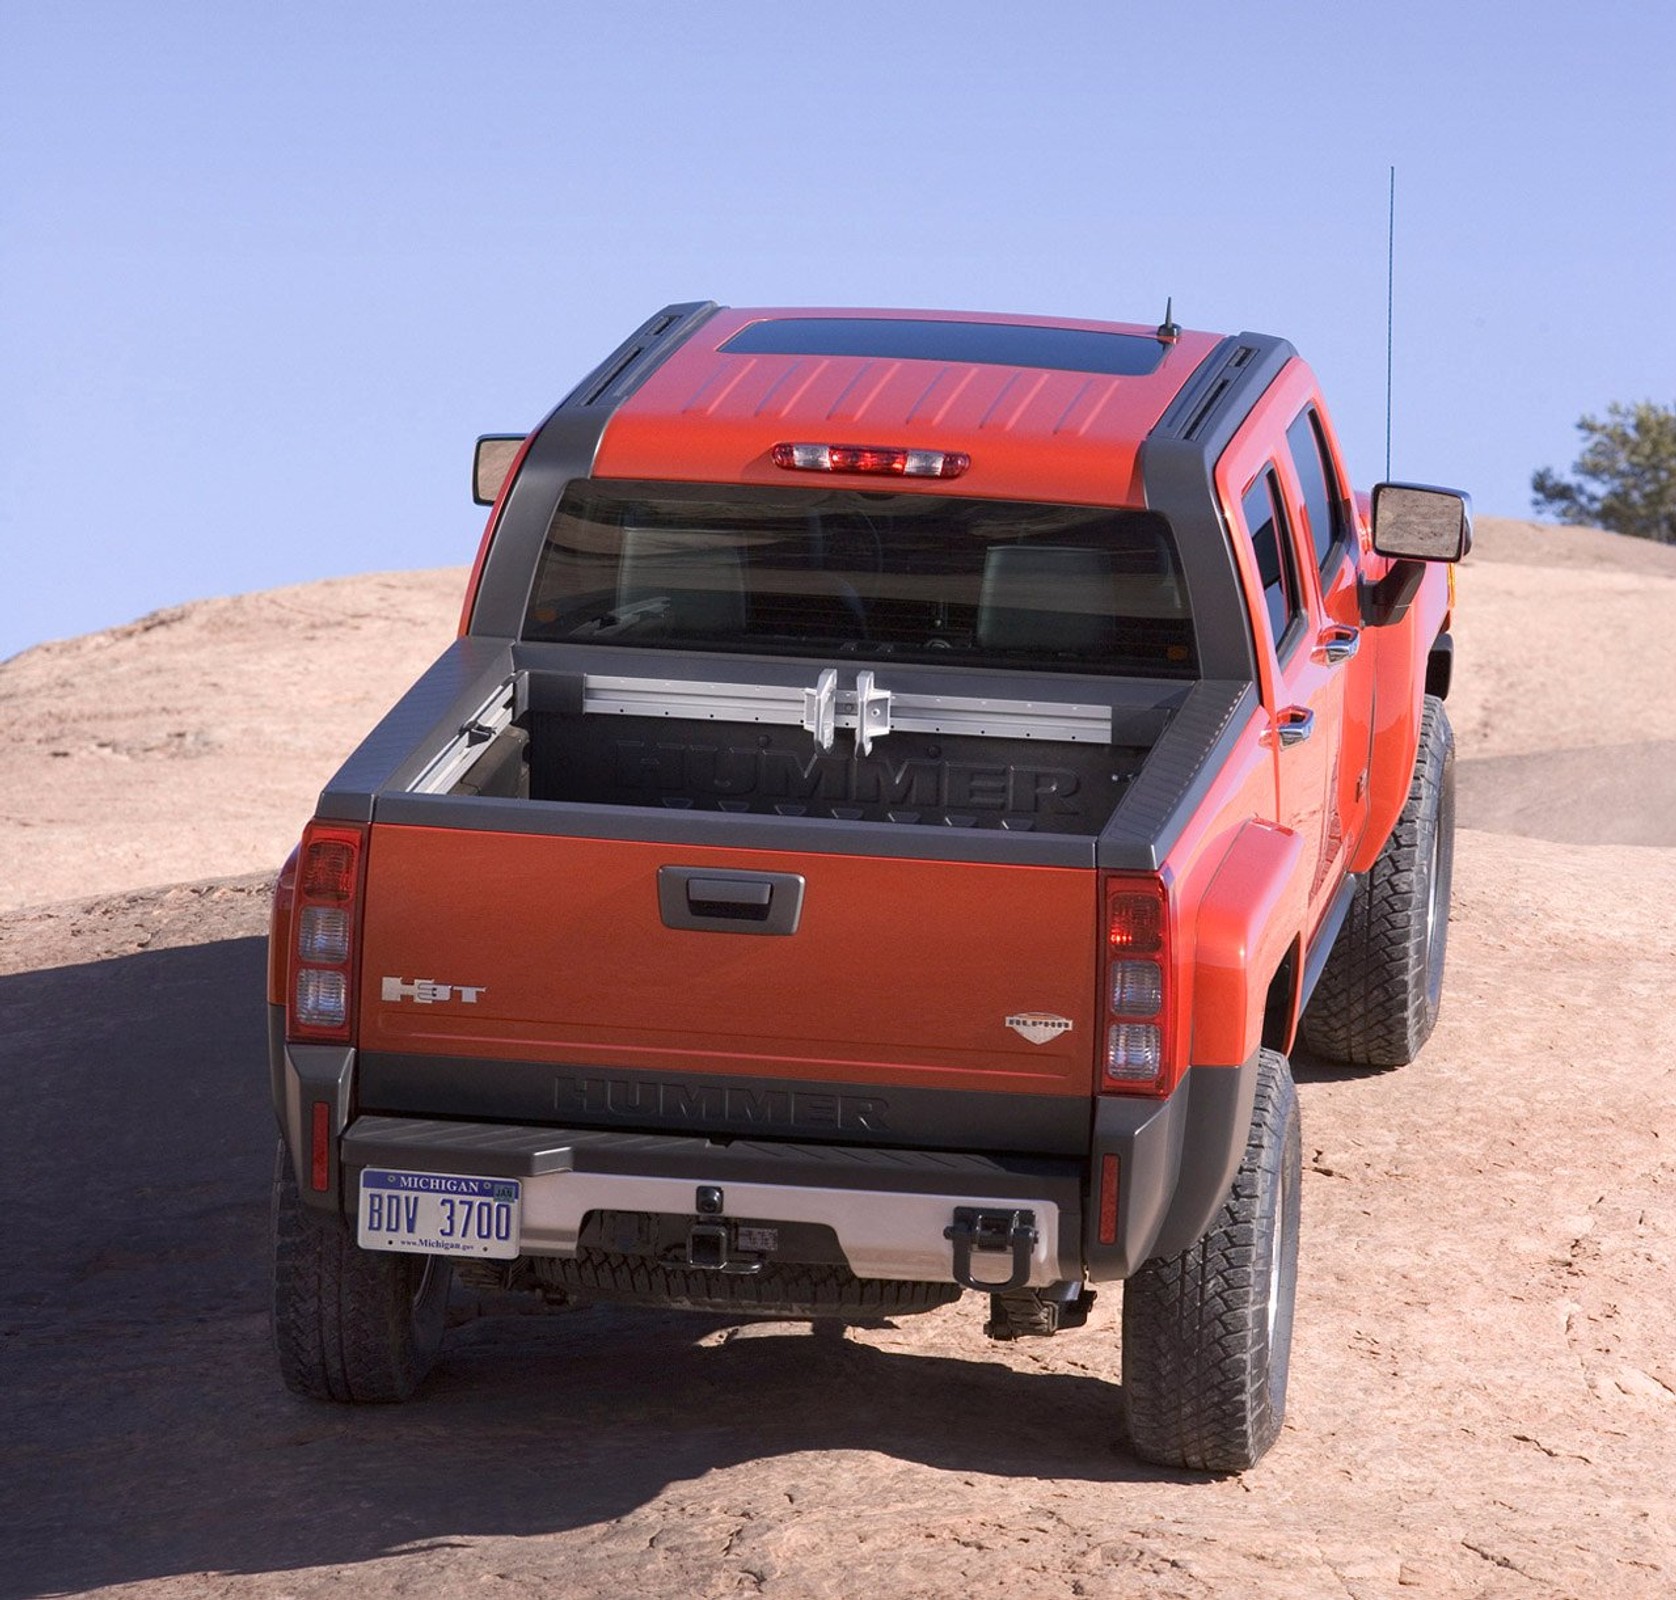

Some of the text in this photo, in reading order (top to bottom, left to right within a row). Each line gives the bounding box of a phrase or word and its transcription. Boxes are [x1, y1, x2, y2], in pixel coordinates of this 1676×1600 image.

[616, 740, 1080, 815] HUMMER
[382, 976, 486, 1003] H3T
[554, 1076, 890, 1131] HUMMER
[400, 1175, 480, 1193] MICHIGAN
[368, 1194, 511, 1241] BDV 3700
[400, 1237, 475, 1251] www.Michigan.gov
